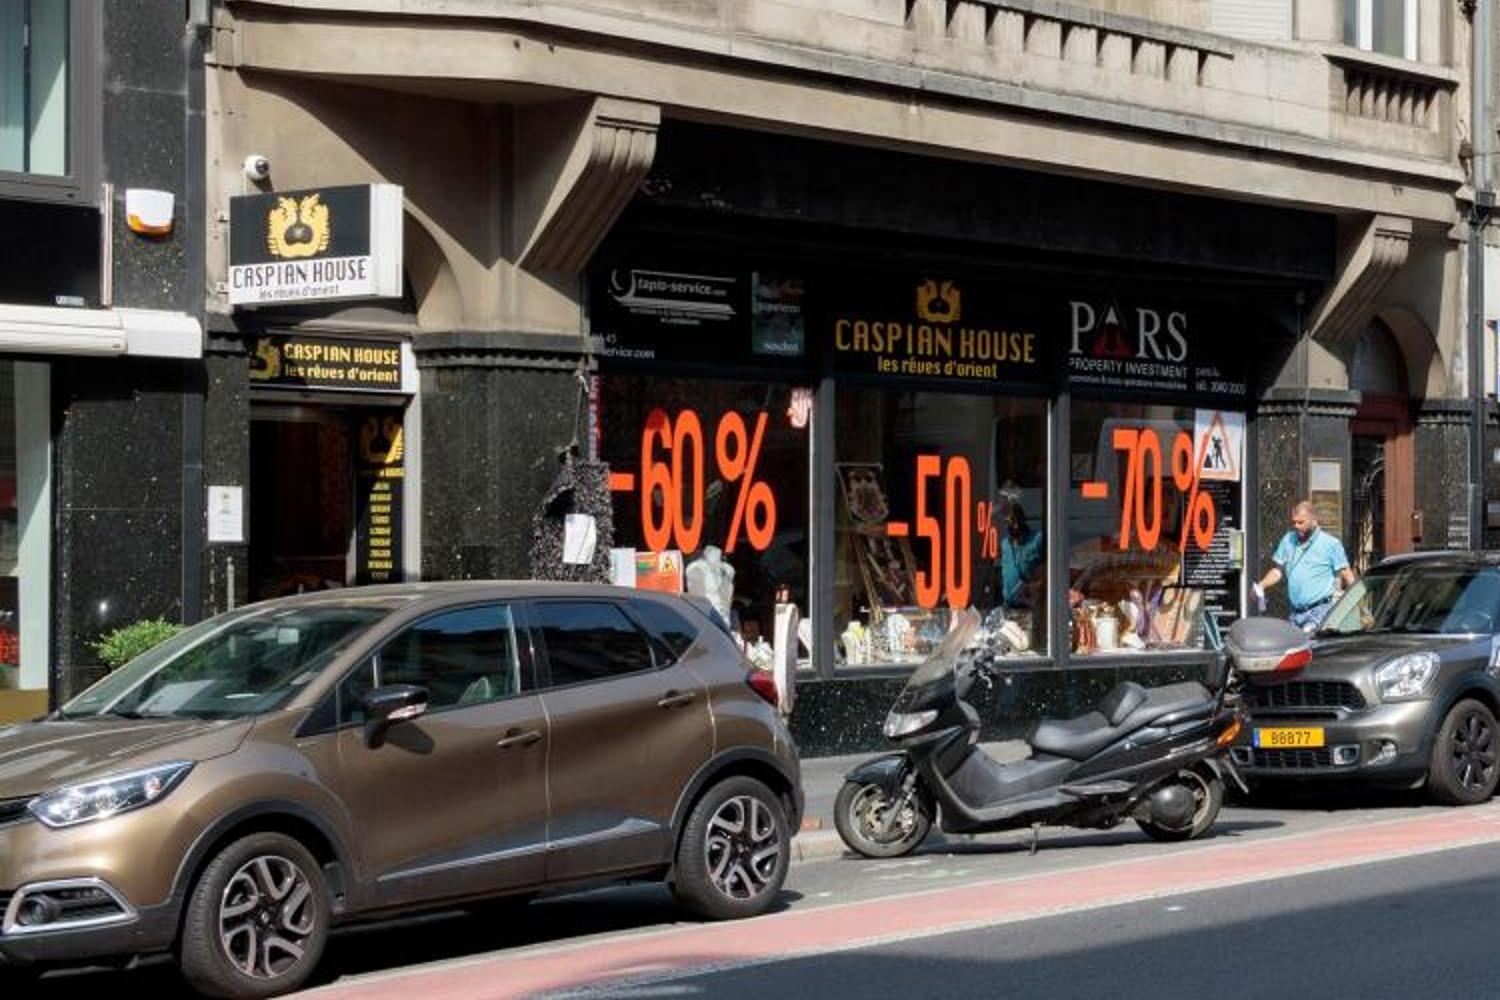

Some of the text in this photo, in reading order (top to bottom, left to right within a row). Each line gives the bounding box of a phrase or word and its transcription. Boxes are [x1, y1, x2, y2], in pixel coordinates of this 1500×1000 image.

[233, 258, 367, 289] CASPIAN HOUSE
[284, 343, 399, 365] CASPIAN HOUSE
[835, 319, 1036, 363] CASPIAN HOUSE
[285, 363, 399, 383] les rêves d'orient
[878, 355, 898, 373] les
[943, 359, 998, 379] d'orient
[1069, 357, 1124, 373] PROPERTY
[1081, 429, 1216, 552] -70%
[887, 454, 998, 609] -50%
